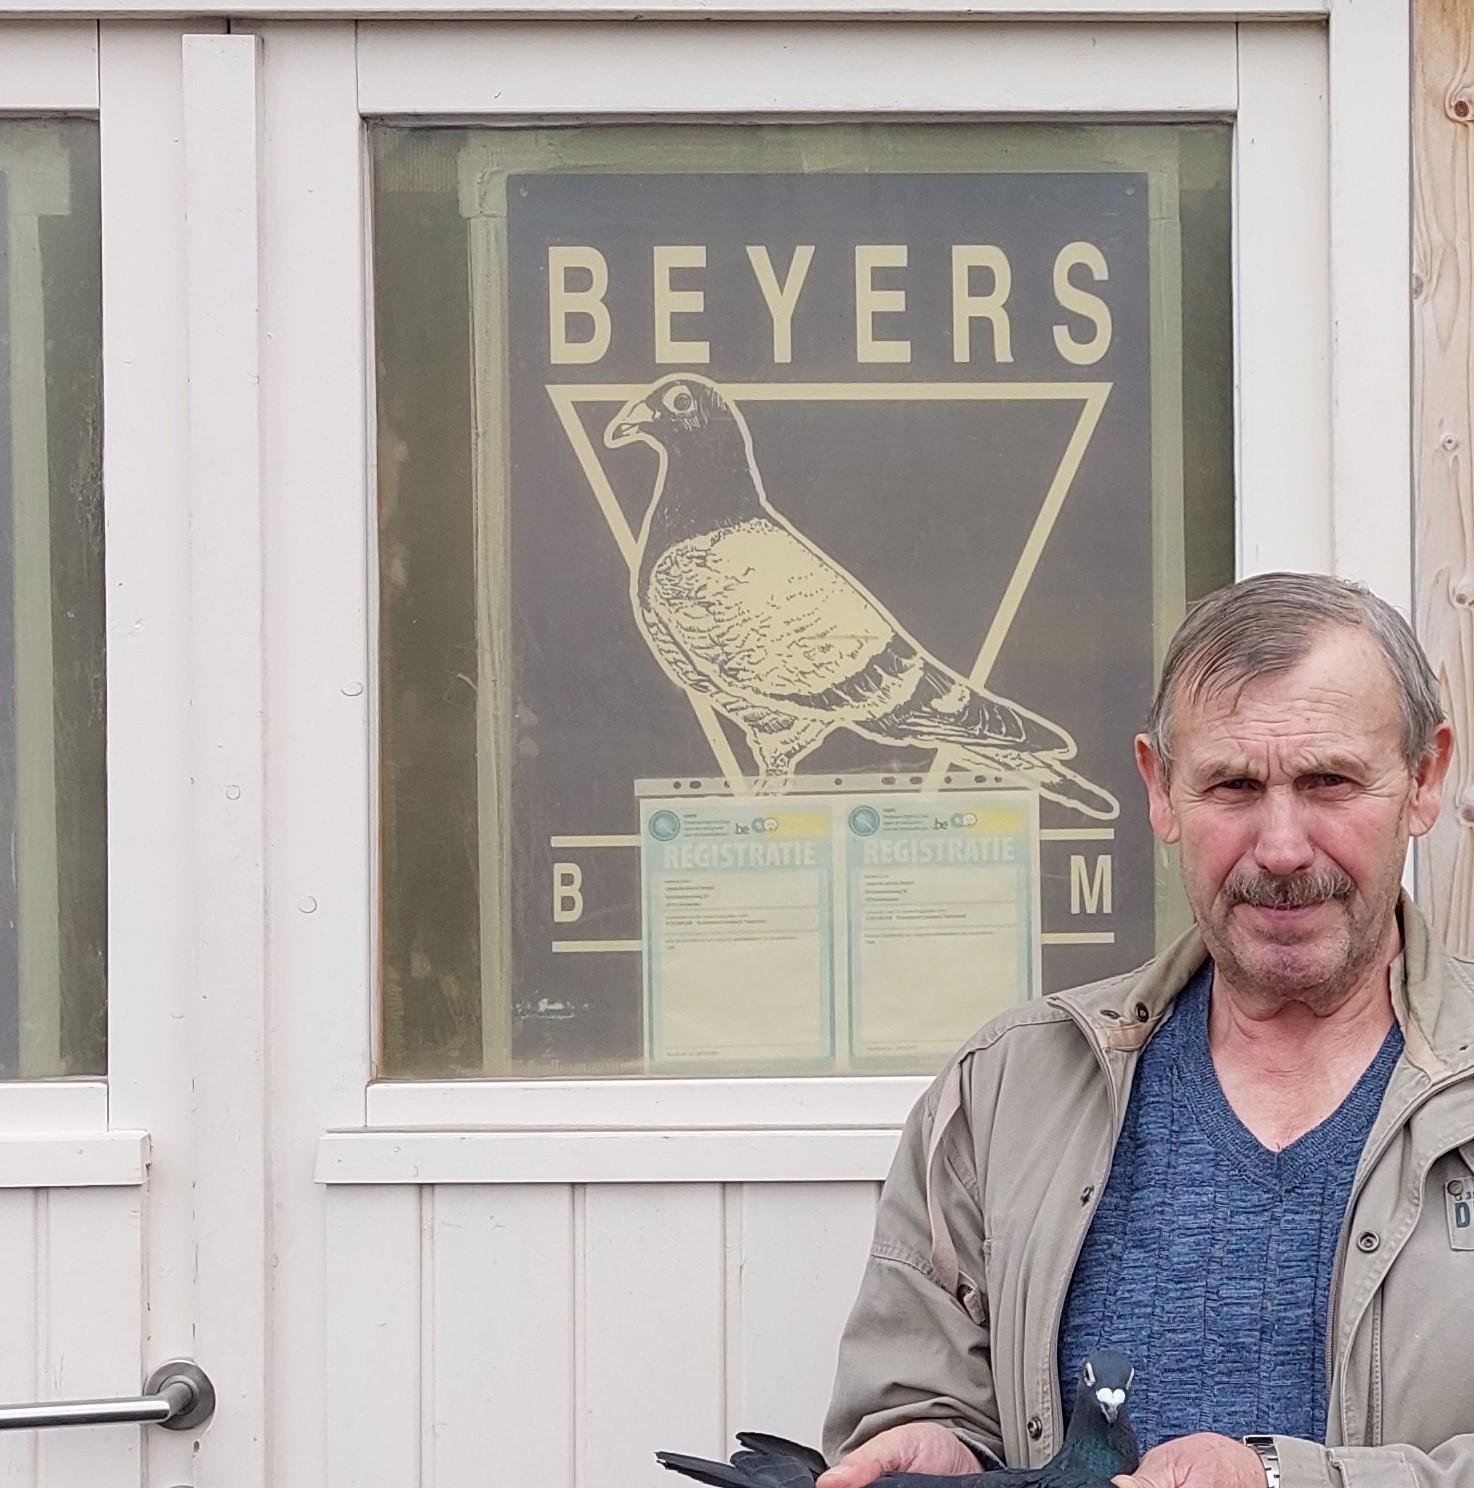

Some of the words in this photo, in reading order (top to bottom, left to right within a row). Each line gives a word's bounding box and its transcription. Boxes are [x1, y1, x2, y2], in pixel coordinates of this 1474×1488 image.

[548, 241, 1112, 366] BEYERS
[663, 841, 816, 868] REGISTRATIE
[862, 837, 1016, 864] REGISTRATIE
